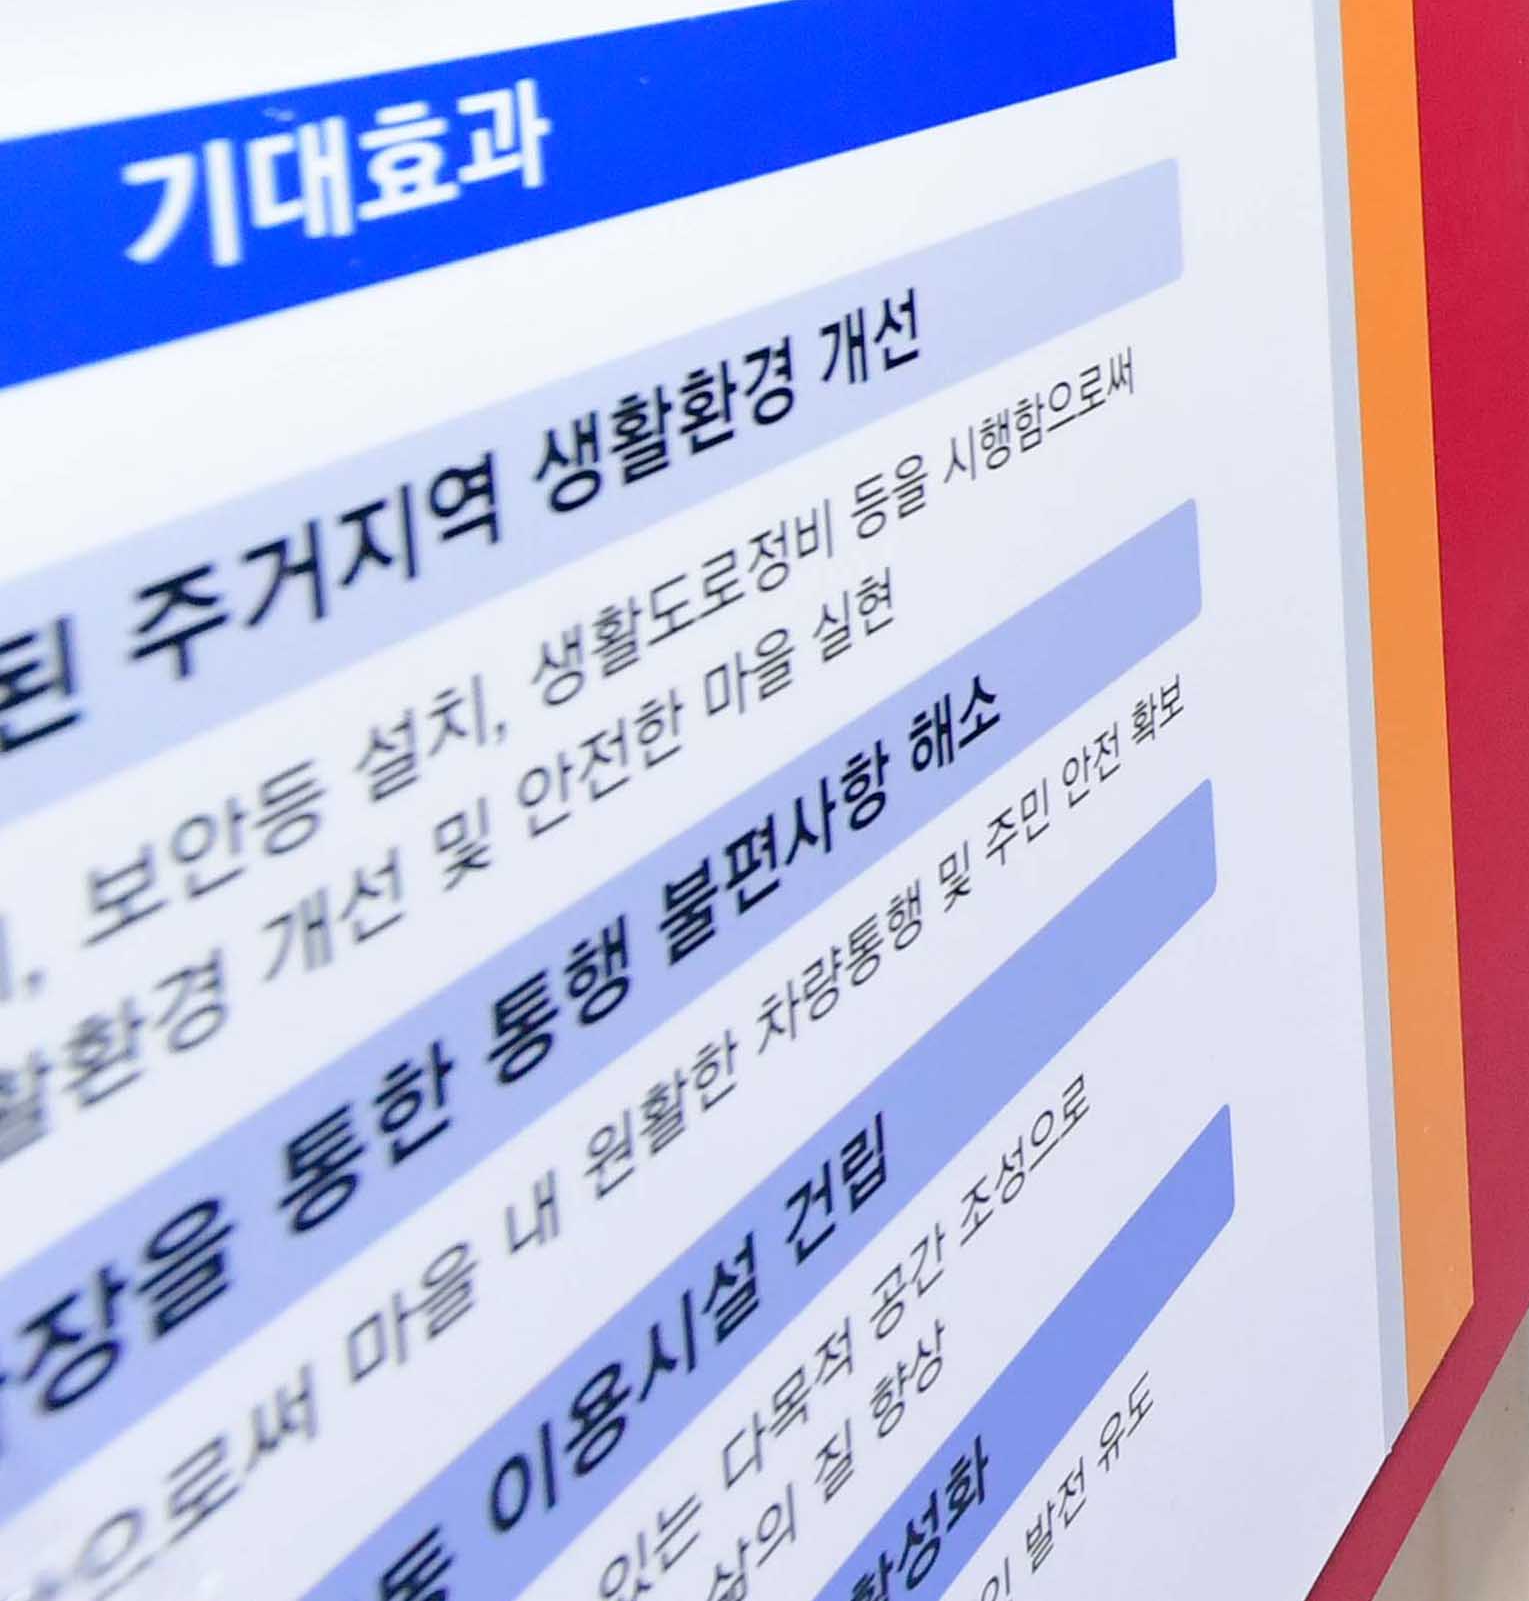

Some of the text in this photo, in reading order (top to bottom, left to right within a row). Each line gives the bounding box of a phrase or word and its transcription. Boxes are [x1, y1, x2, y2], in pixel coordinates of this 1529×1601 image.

[120, 77, 553, 267] 기대효과
[0, 286, 922, 755] 된 주거지역 생활환경 개선
[80, 346, 1137, 950] 보안등 설치, 생활도로정비 등을 시행함으로써
[260, 846, 405, 983] 개선
[432, 796, 494, 893] 및
[515, 687, 686, 840] 안전한
[702, 625, 796, 719] 마을
[810, 565, 896, 665] 실현
[0, 674, 1002, 1419] 장을 통한 통행 불편사항 해소
[28, 673, 1186, 1601] 으로써 마을 내 원활한 차량통행 및 주민 안전 확보
[488, 1231, 762, 1534] 이용시설
[784, 1110, 888, 1267] 건립
[595, 1073, 1092, 1601] 있는 다목적 공간 조성으로
[814, 1318, 946, 1504] 질 향상
[1024, 1370, 1155, 1575] 발전 유도
